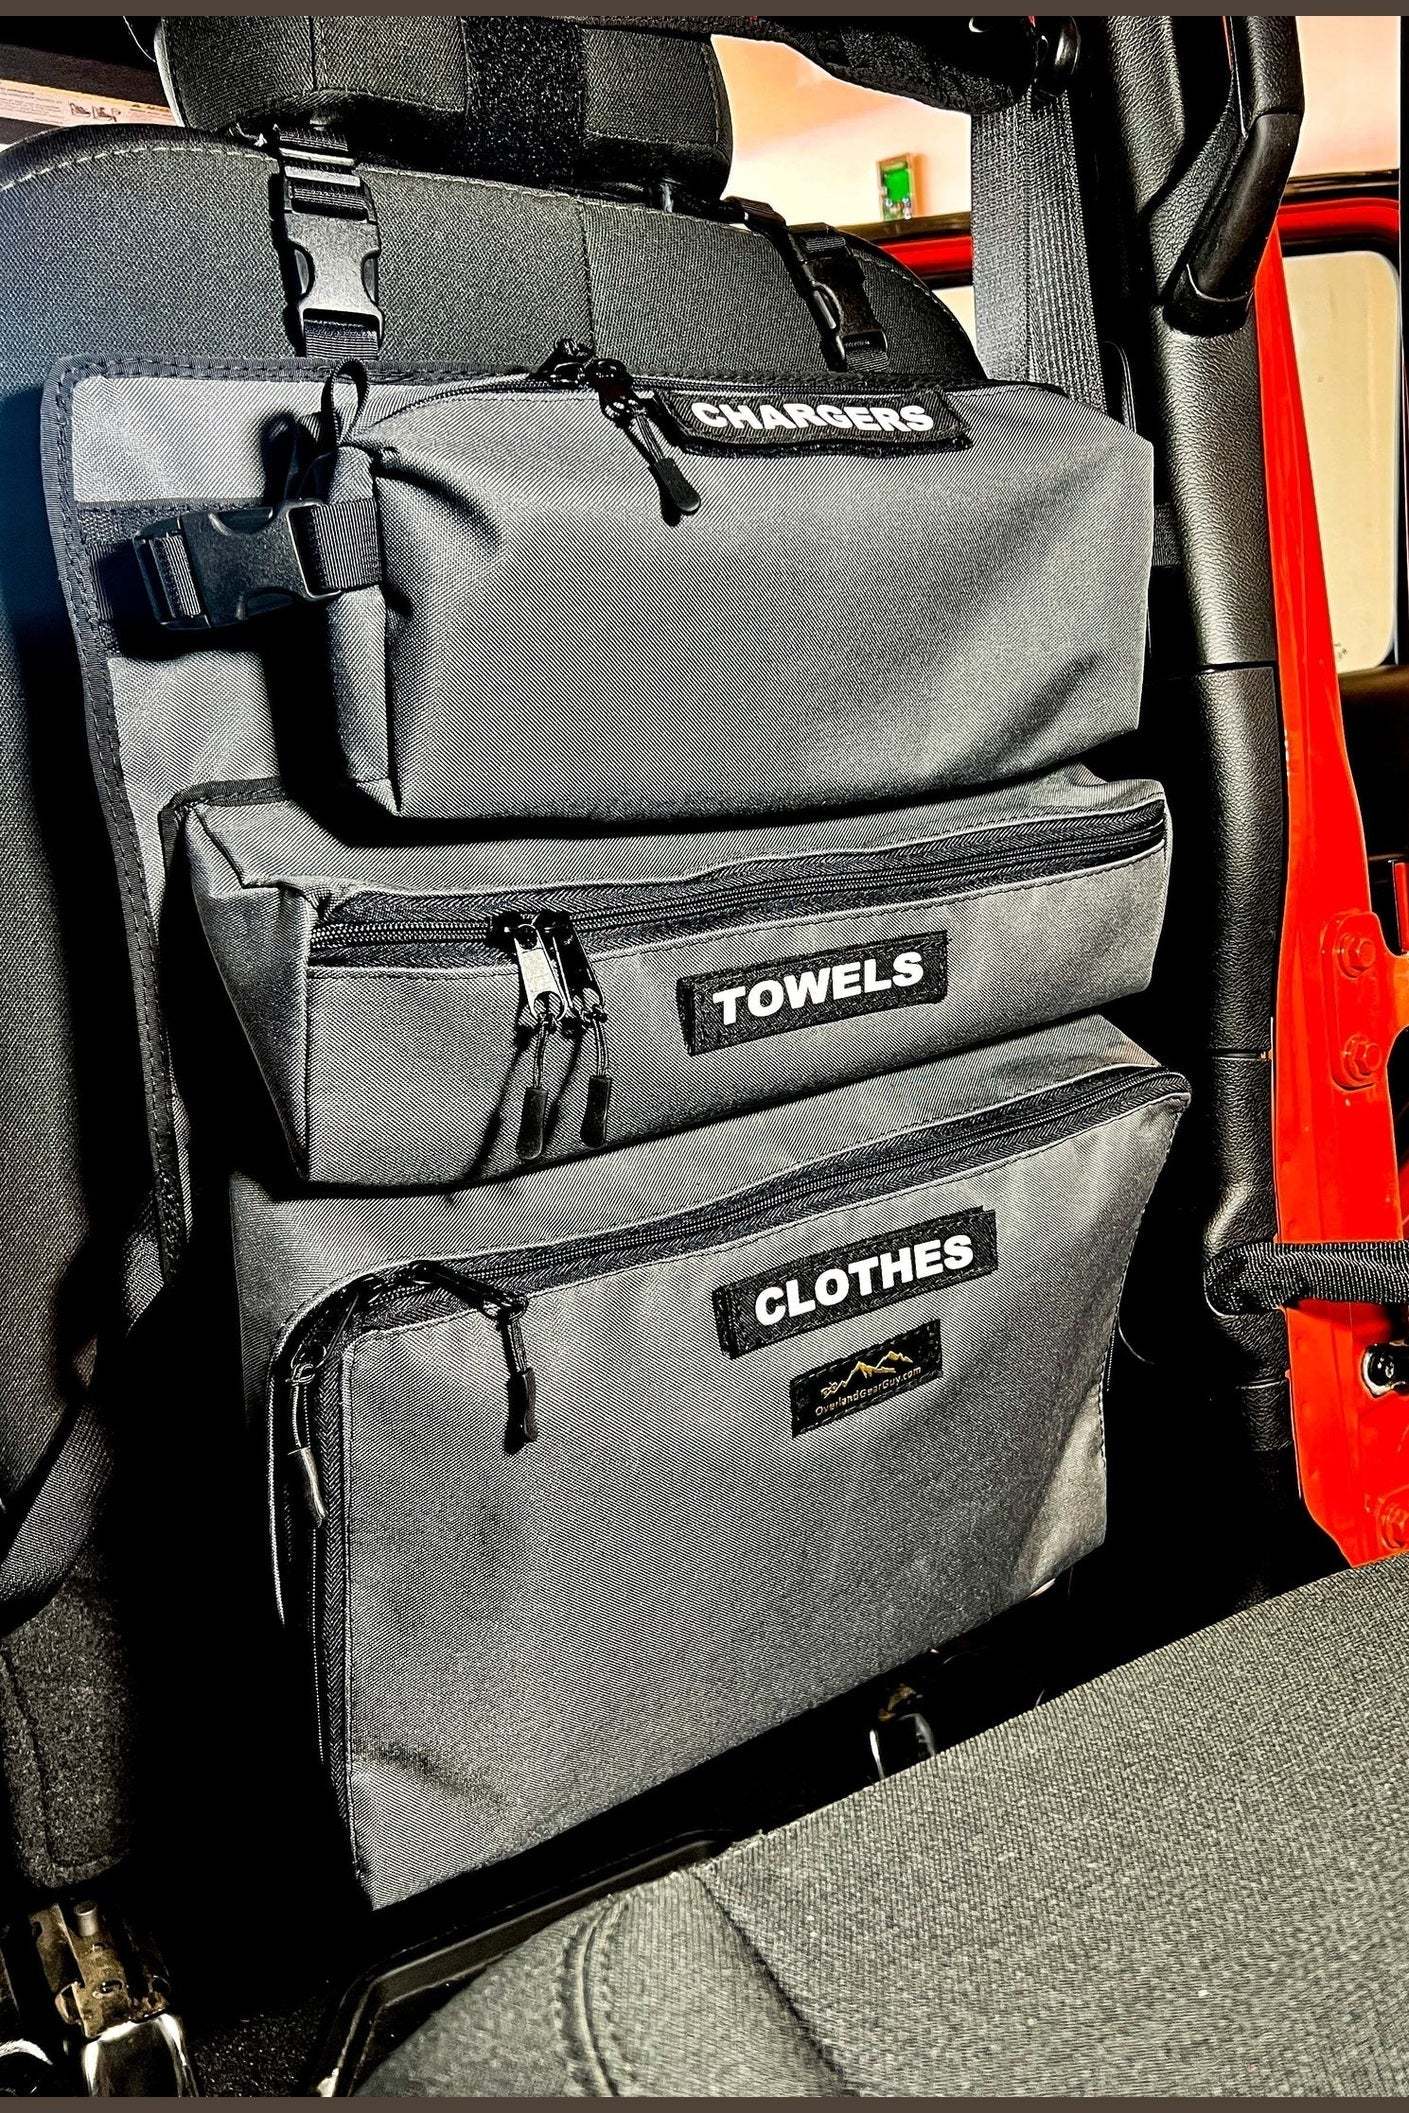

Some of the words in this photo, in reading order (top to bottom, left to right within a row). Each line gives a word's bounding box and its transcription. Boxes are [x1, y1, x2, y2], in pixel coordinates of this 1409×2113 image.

[691, 402, 934, 432] CHARGERS
[713, 951, 924, 1026] TOWELS
[755, 1234, 974, 1326] CLOTHES
[814, 1365, 922, 1417] OverlandGearGuy.com
